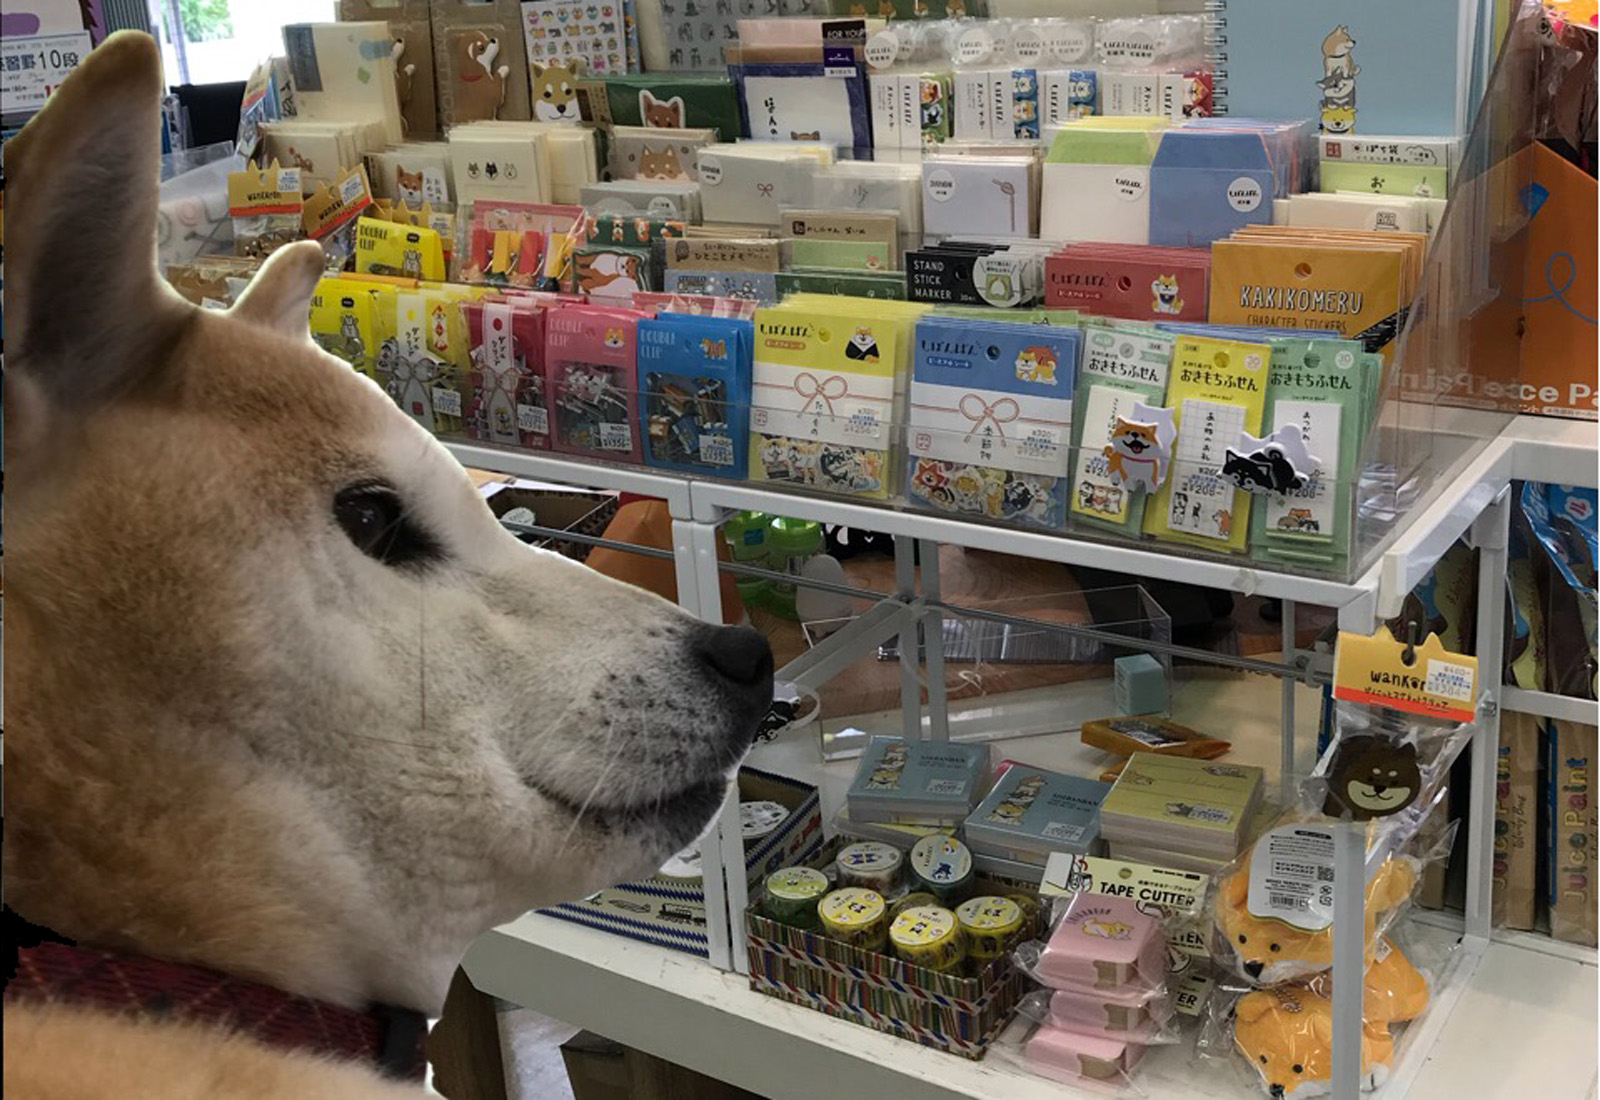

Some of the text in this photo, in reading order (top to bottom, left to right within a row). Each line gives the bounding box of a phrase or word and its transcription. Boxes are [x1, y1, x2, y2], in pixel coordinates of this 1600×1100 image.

[913, 259, 945, 272] STAND
[914, 274, 942, 286] STICK
[914, 287, 952, 300] MARKER
[1240, 284, 1363, 314] KAKIKOMERU
[1247, 314, 1347, 334] CHARACTER STICKERS
[640, 329, 676, 344] DOUBLE
[641, 345, 663, 359] CLIP
[1088, 357, 1160, 382] おきもちふせん
[1180, 368, 1259, 392] おきもちふせん
[1270, 372, 1352, 390] おきもちふせん
[1562, 756, 1588, 903] Juice Paint
[1100, 881, 1196, 907] TAPE CUTTER
